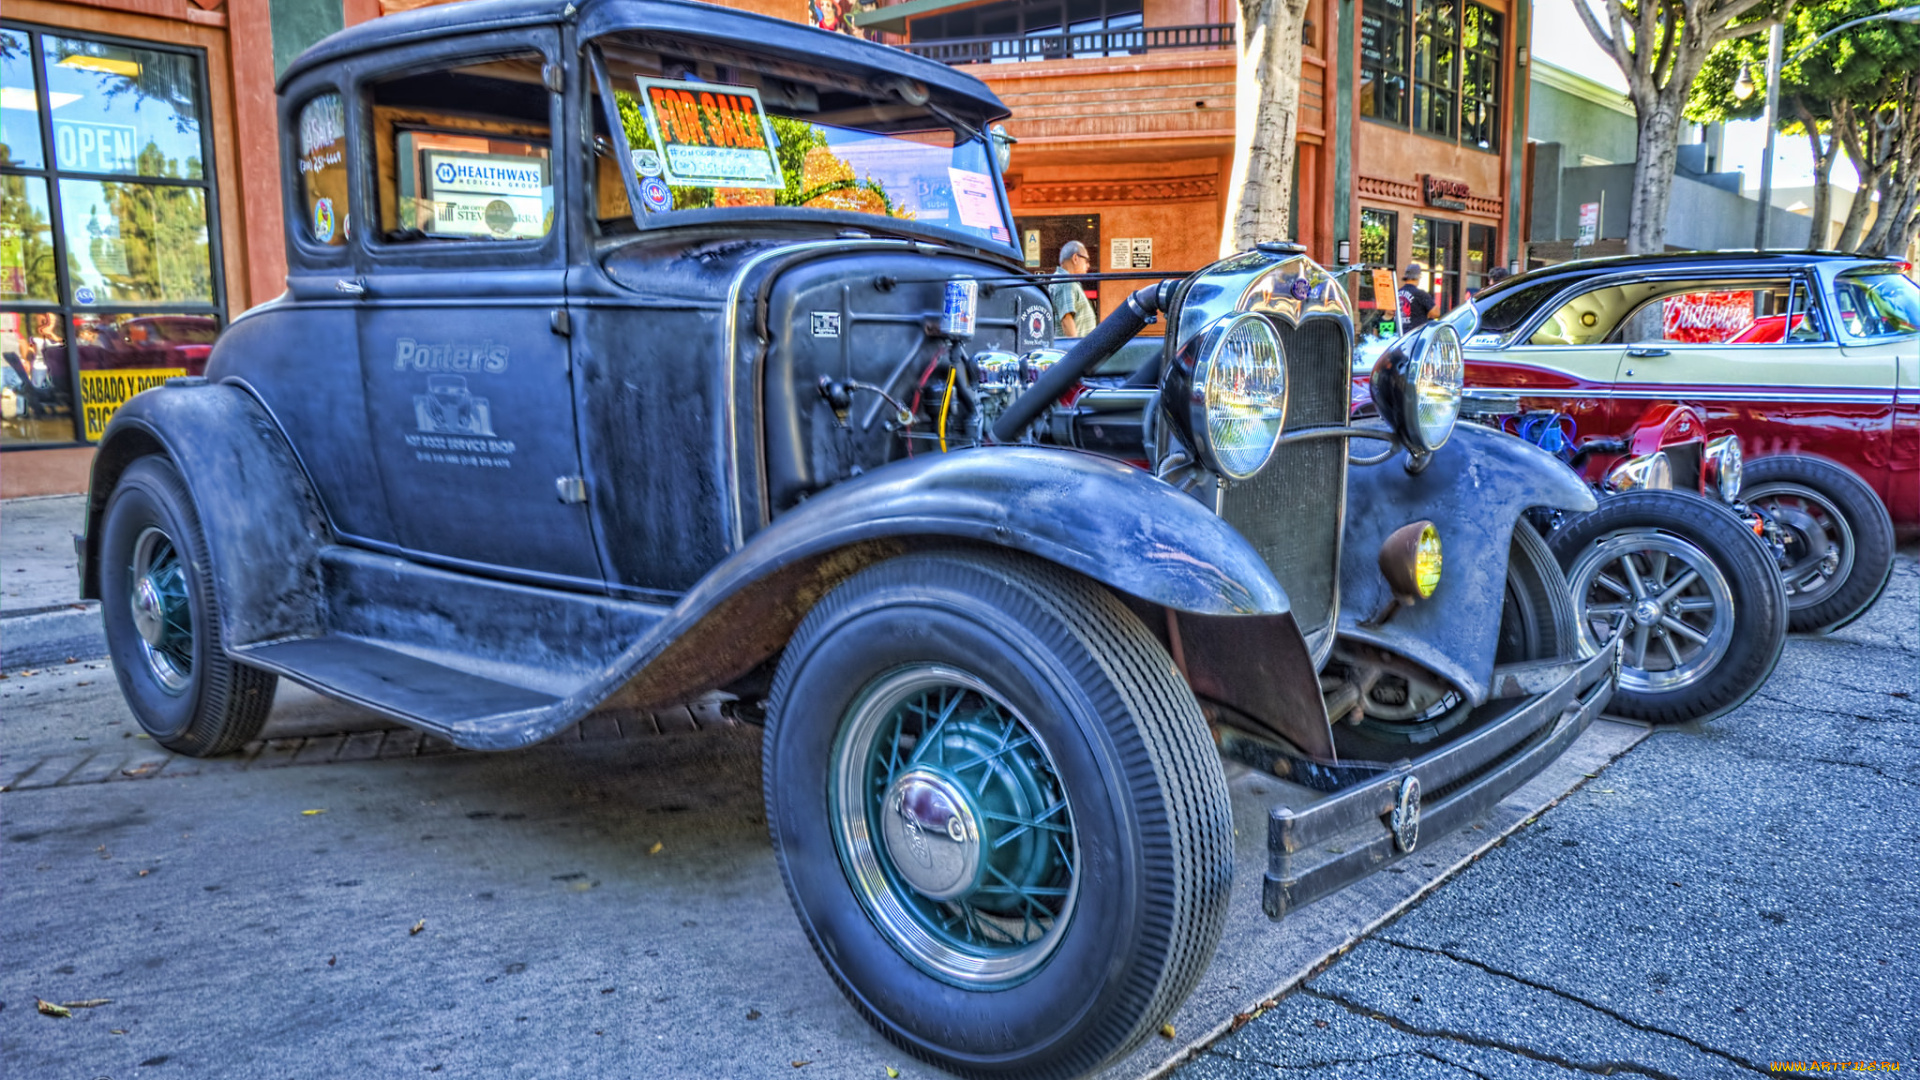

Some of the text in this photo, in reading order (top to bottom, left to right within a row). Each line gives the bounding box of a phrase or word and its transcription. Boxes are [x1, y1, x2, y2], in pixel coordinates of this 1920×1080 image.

[650, 87, 765, 148] FOR SALE
[57, 125, 132, 171] OPEN
[457, 165, 539, 183] HEALTHWAYS
[459, 178, 502, 187] MEDICAL
[649, 187, 664, 199] AAA
[1028, 233, 1037, 243] A
[76, 290, 94, 299] ASA
[1663, 293, 1750, 333] Budweiser
[394, 337, 509, 373] Porter's
[82, 376, 126, 404] SABADO
[127, 376, 135, 397] Y
[447, 437, 488, 453] SERVICE
[488, 440, 516, 454] SHOP
